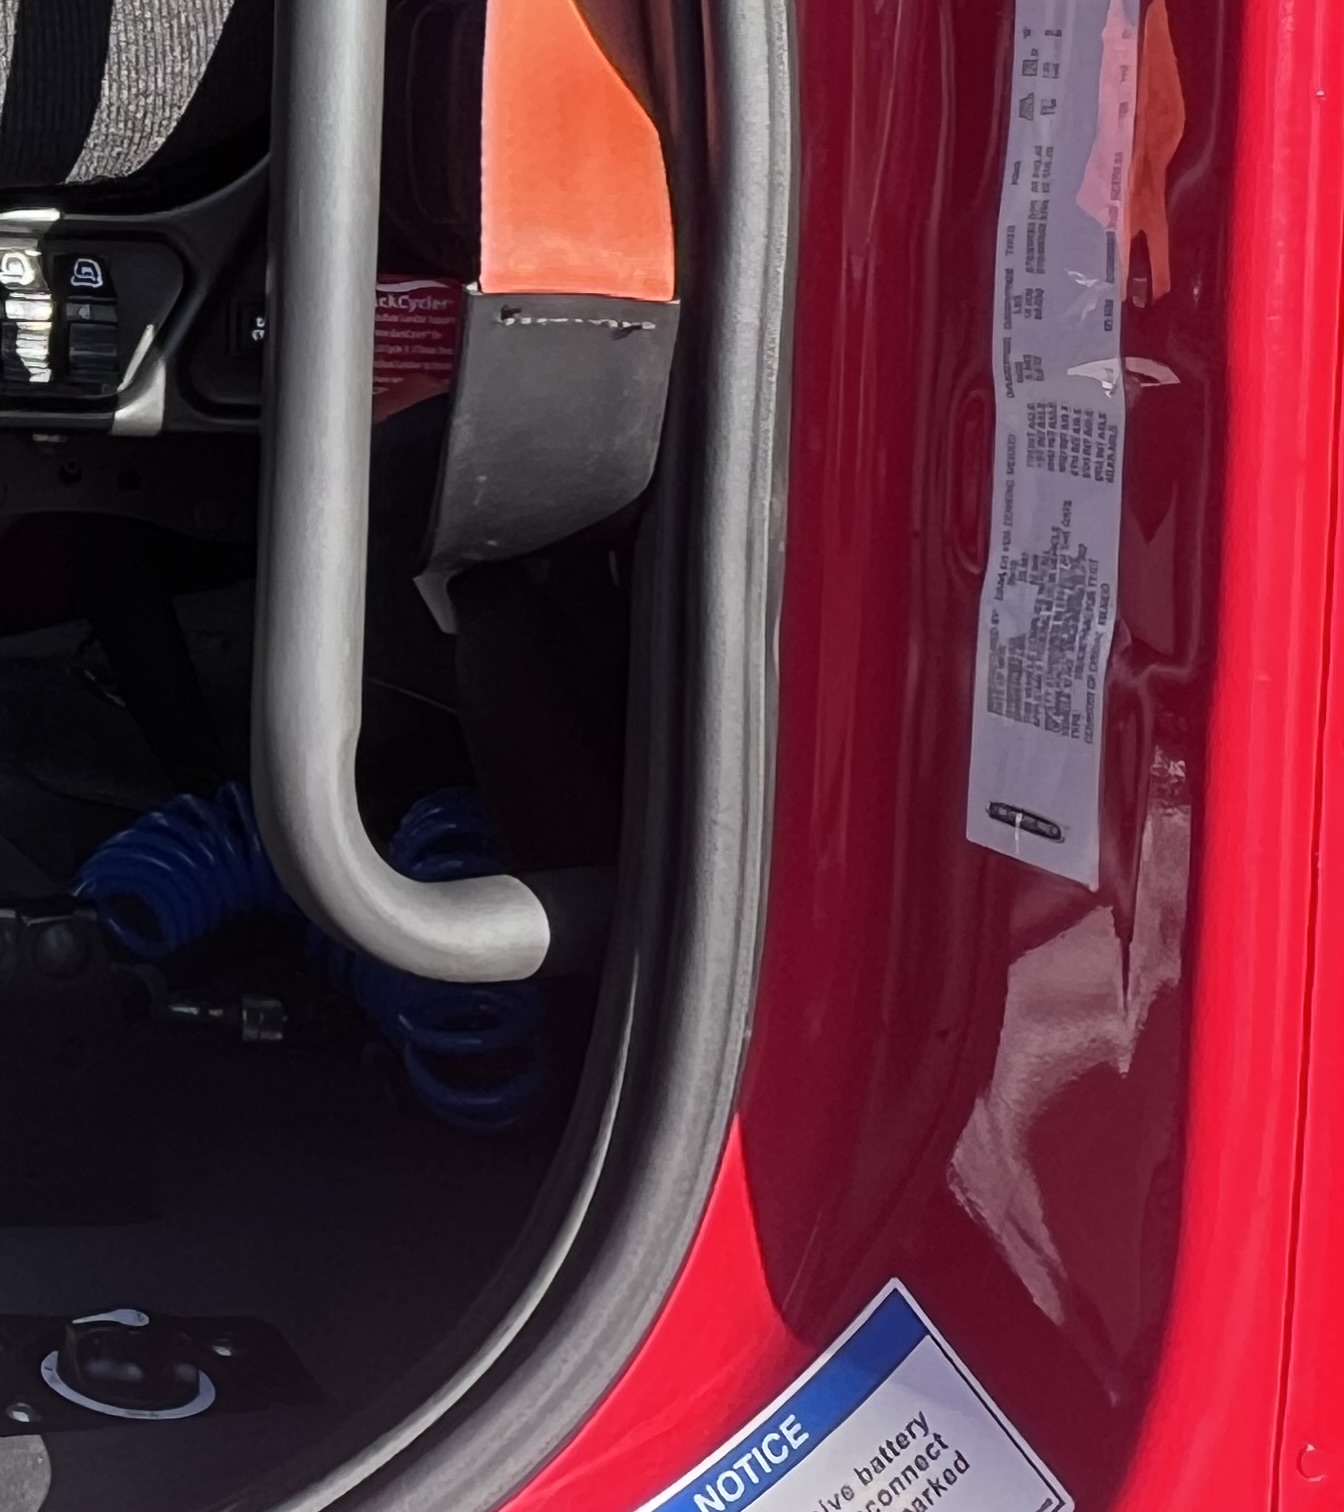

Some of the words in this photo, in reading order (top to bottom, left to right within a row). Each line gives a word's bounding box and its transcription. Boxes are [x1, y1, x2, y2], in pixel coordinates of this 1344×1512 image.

[375, 295, 448, 312] ckCycler
[693, 1413, 810, 1512] NOTICE
[854, 1411, 929, 1486] battery
[858, 1432, 949, 1512] connect
[903, 1450, 970, 1512] arked
